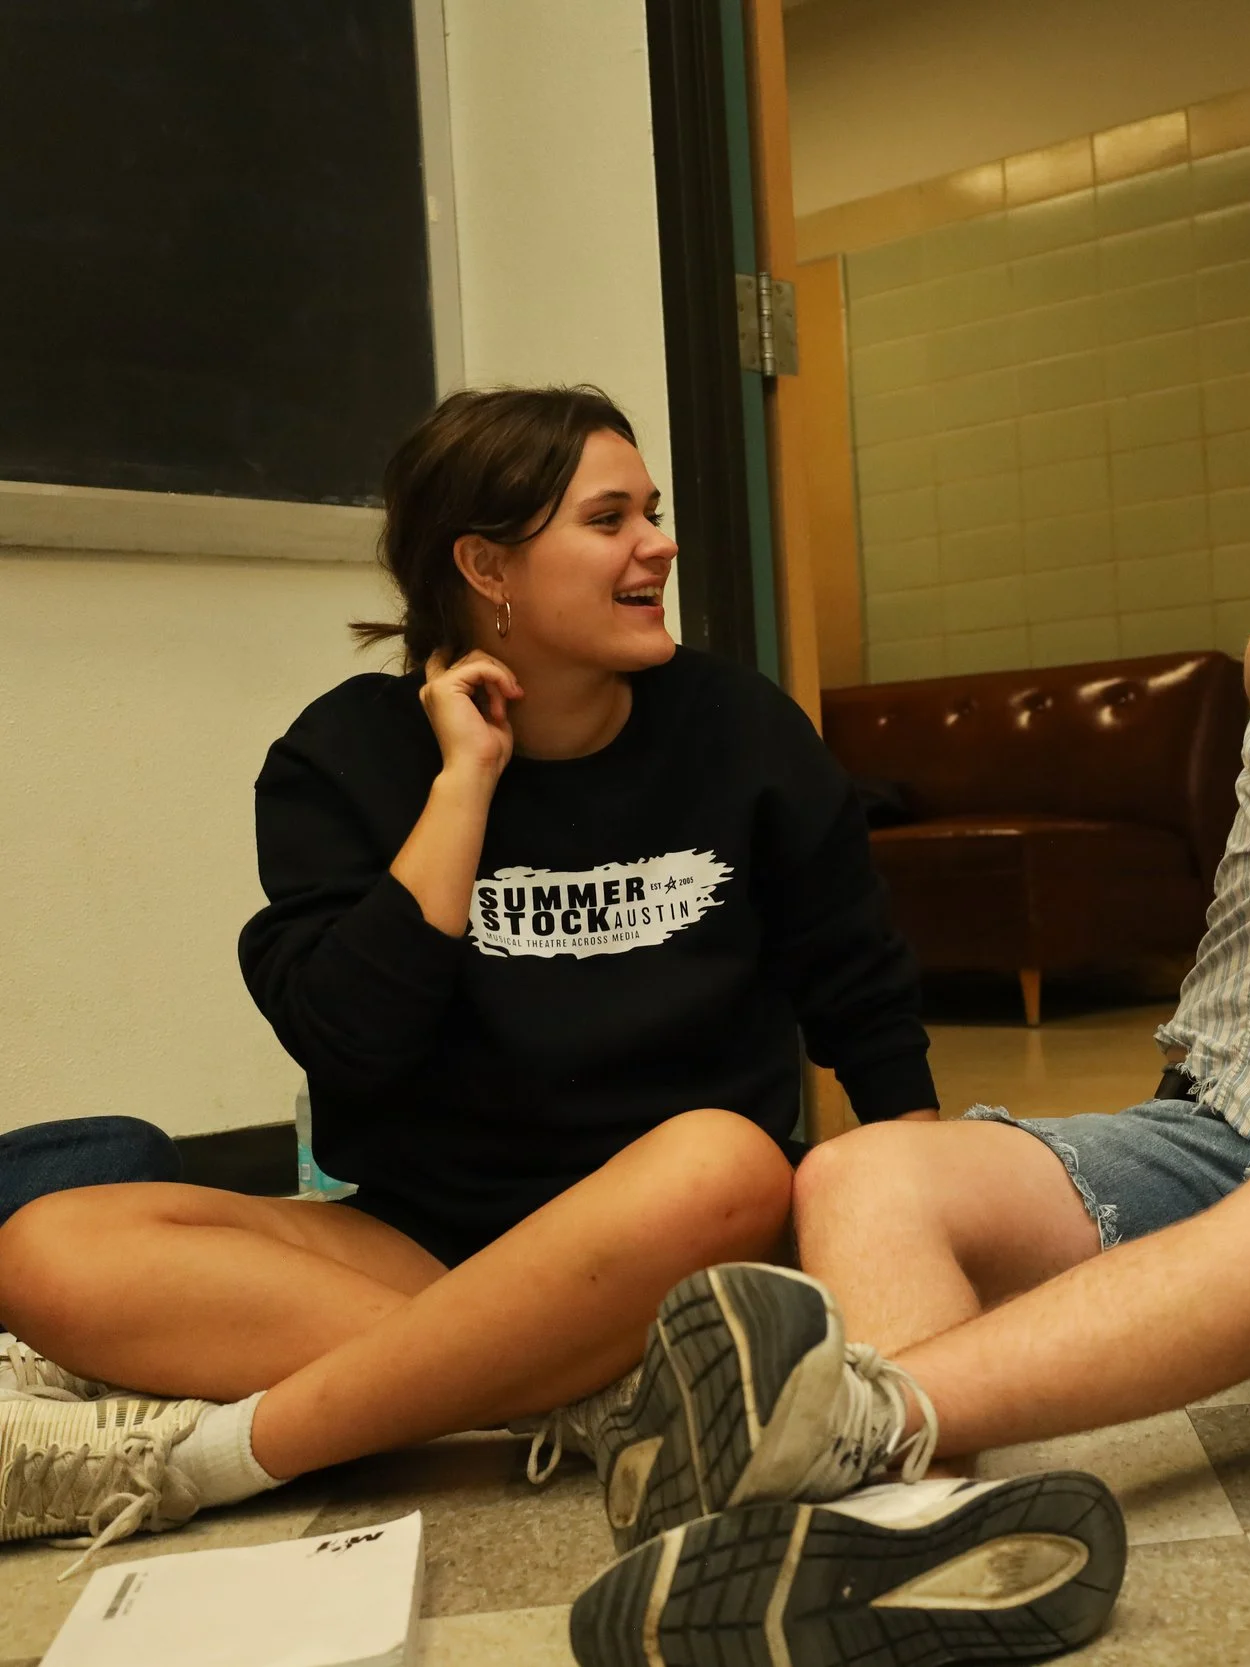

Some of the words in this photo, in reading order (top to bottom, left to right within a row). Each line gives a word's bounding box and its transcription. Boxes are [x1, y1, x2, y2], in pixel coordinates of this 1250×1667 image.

[477, 876, 646, 912] SUMMER
[650, 882, 661, 891] EST
[679, 876, 694, 886] 2005
[480, 906, 610, 936] STOCK
[614, 900, 690, 930] AUSTIN
[486, 932, 522, 948] MUSICAL
[526, 939, 568, 948] THEATRE
[572, 936, 609, 947] ACROSS
[612, 930, 640, 942] MEDIA
